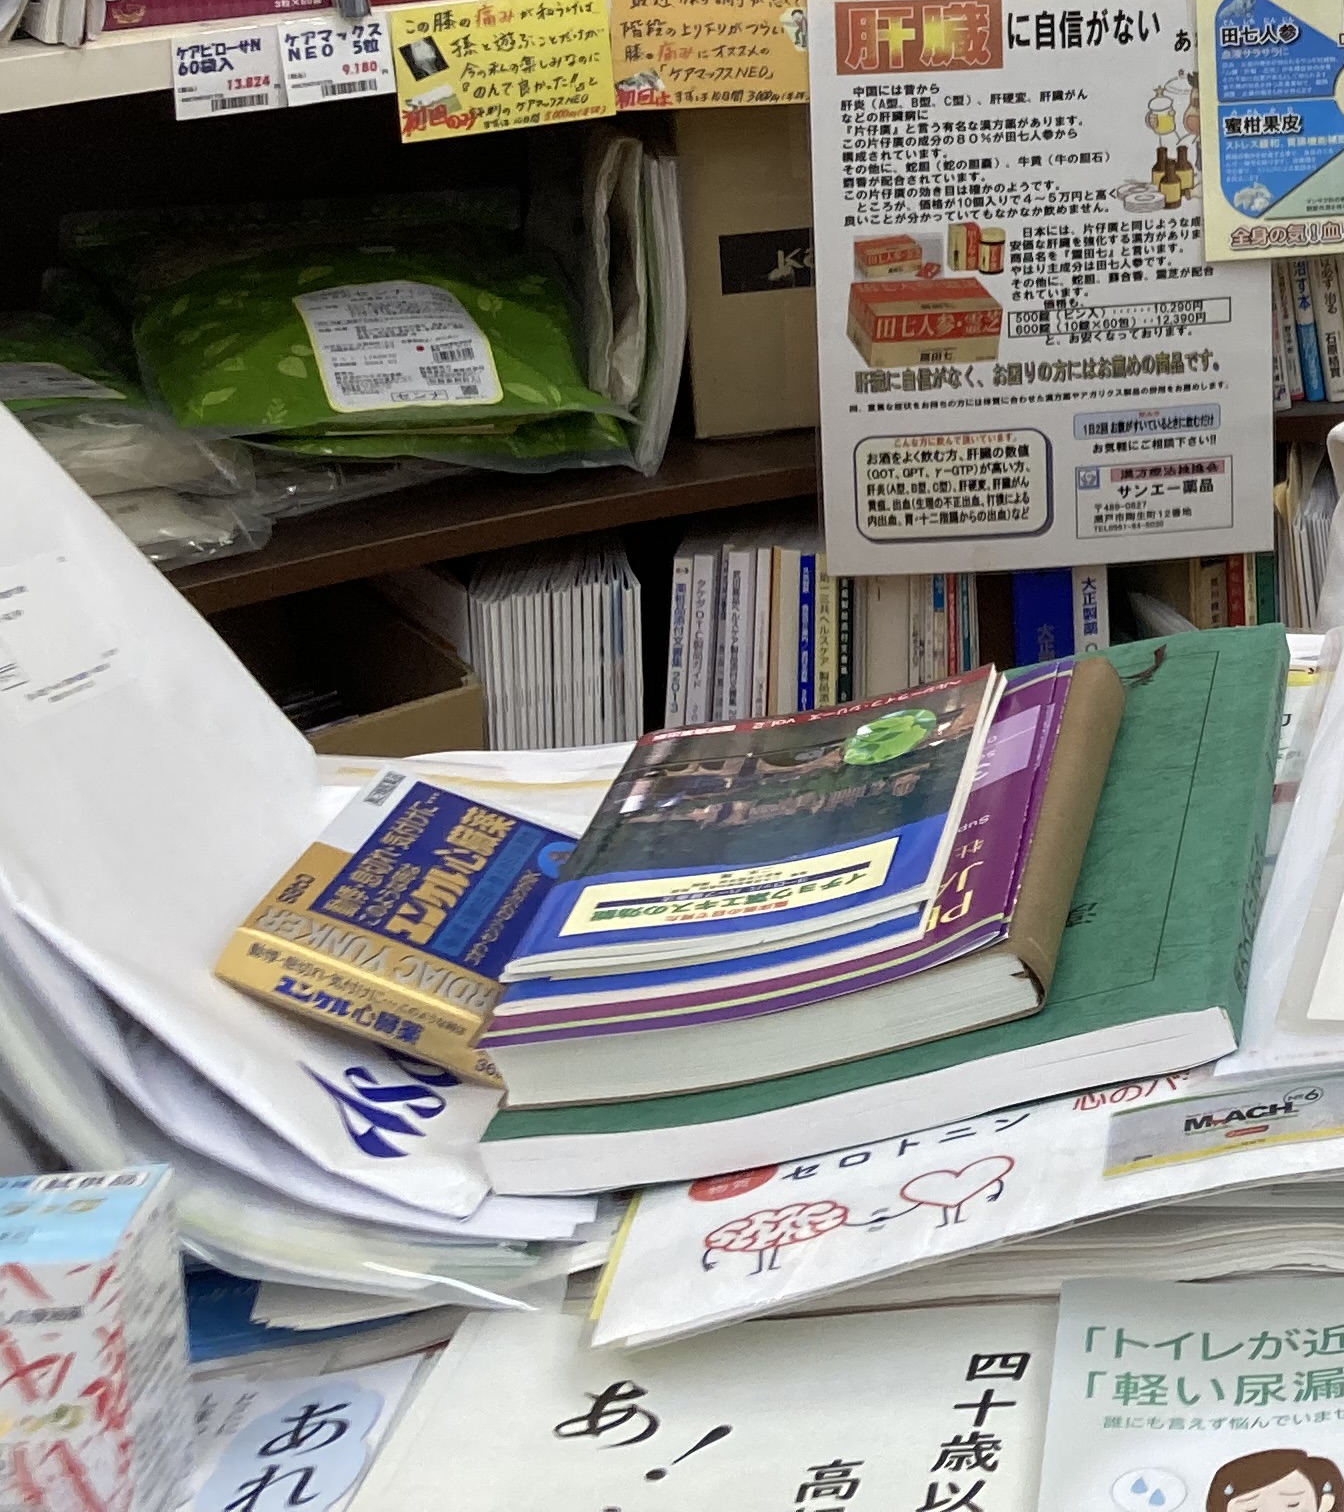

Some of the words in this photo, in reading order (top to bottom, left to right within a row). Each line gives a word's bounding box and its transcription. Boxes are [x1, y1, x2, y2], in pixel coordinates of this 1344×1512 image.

[285, 24, 382, 47] ケアマックス
[845, 0, 990, 71] 肝臓
[1007, 9, 1161, 48] に自信がない
[1221, 24, 1298, 46] 田七人参
[288, 45, 333, 62] NEO
[1225, 114, 1301, 135] 蜜柑果皮
[782, 1112, 1031, 1181] セロトニン
[916, 1352, 1030, 1511] 四十歳以
